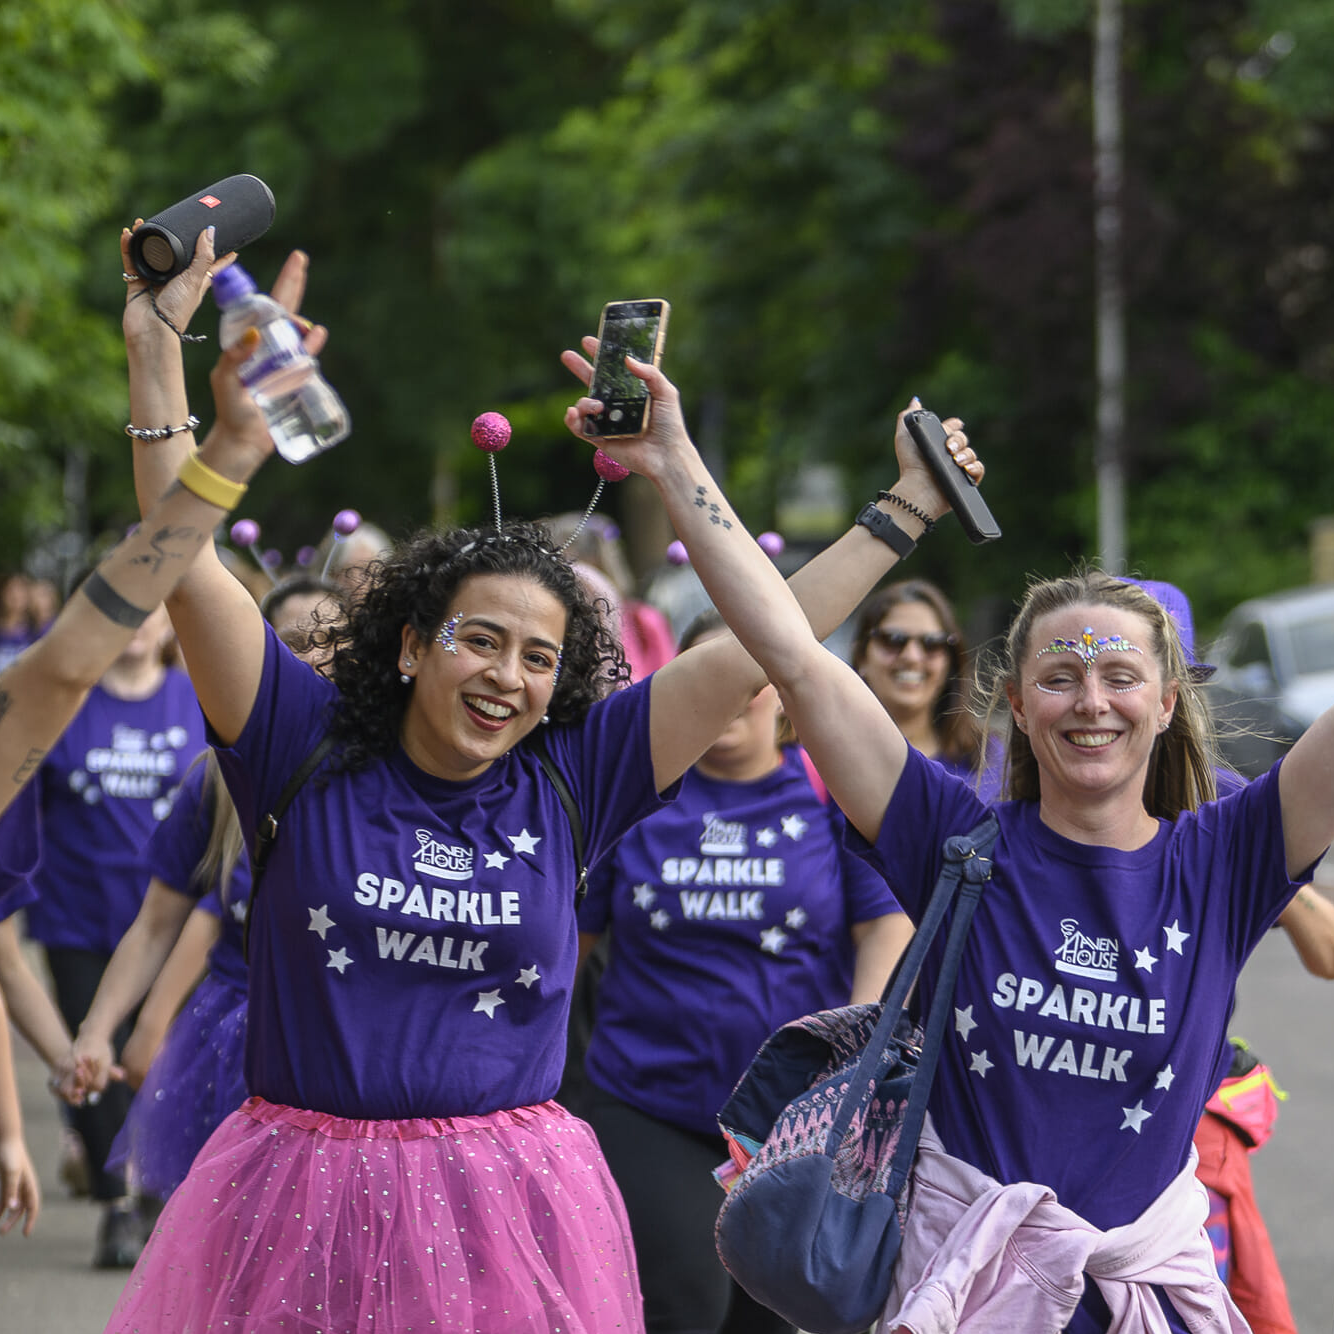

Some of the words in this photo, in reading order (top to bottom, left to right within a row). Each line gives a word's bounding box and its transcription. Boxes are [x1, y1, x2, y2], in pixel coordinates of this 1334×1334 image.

[420, 852, 473, 871] HOUSE
[661, 857, 785, 886] SPARKLE
[353, 872, 521, 925] SPARKLE
[679, 890, 765, 920] WALK
[375, 927, 489, 971] WALK
[1062, 949, 1119, 970] HOUSE
[992, 972, 1166, 1034] SPARKLE
[1013, 1030, 1133, 1082] WALK
